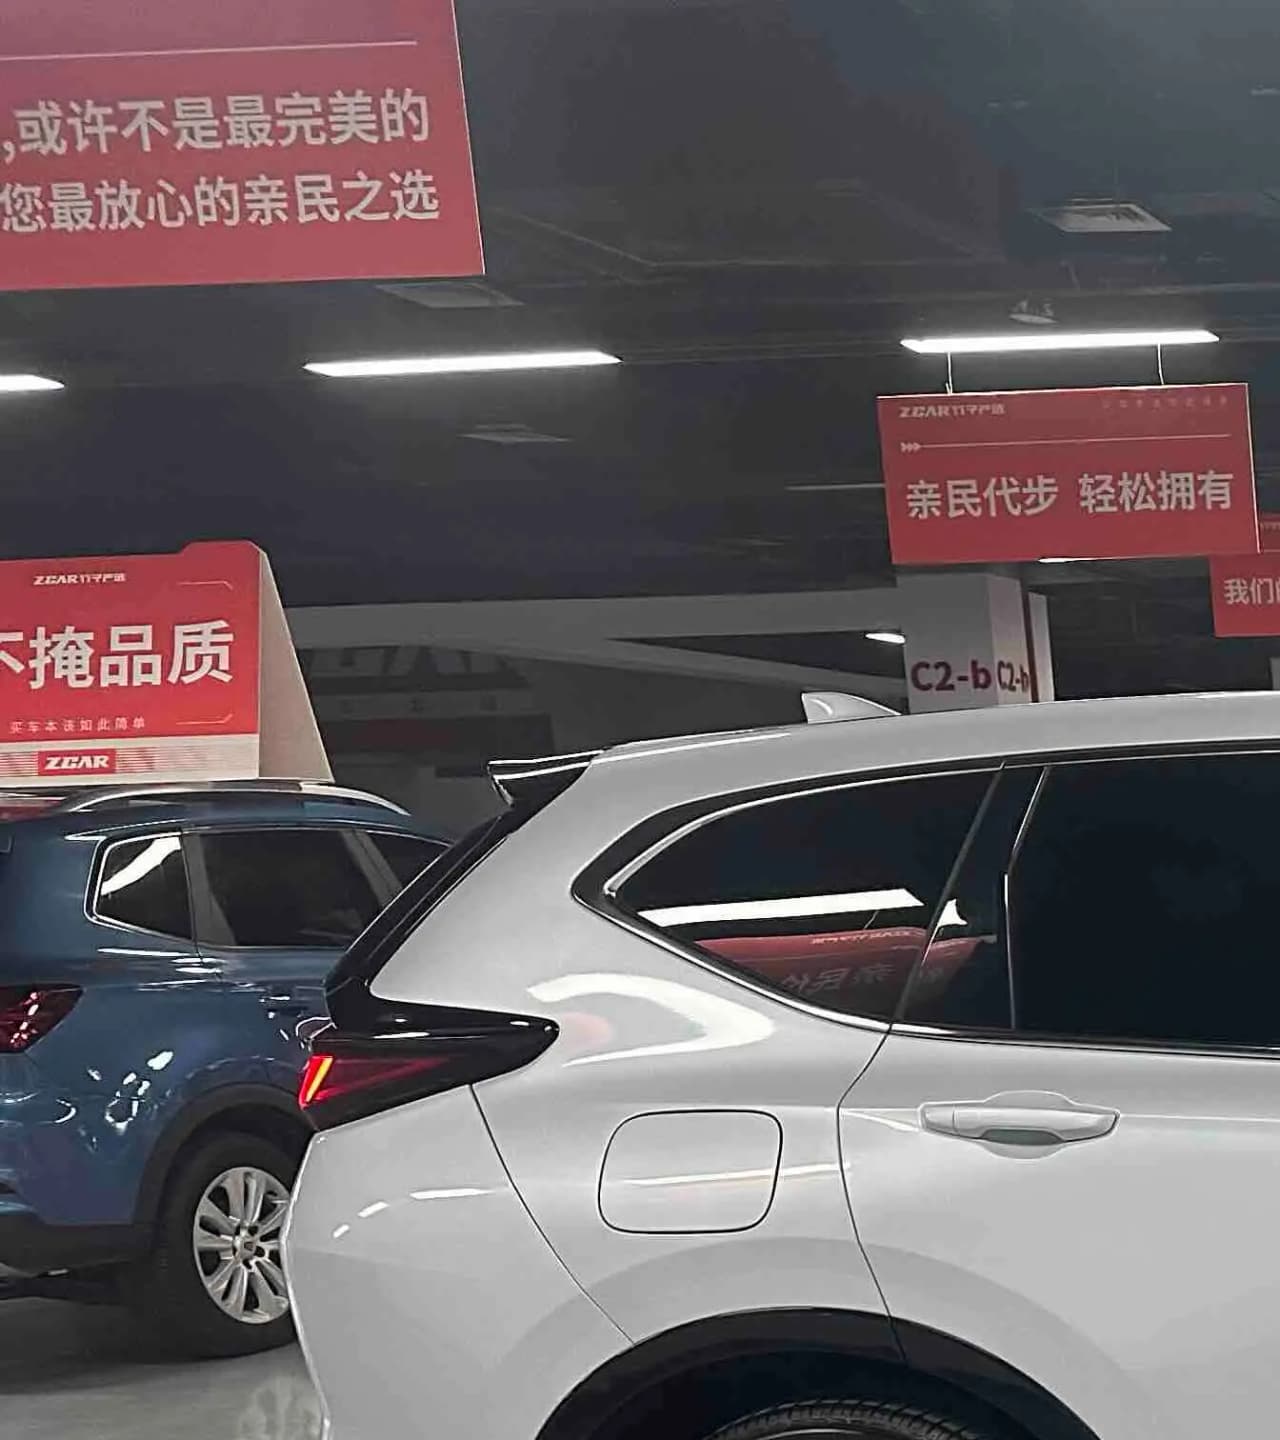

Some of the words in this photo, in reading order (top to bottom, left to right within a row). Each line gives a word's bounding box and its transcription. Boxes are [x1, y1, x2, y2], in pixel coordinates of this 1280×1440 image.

[2, 169, 440, 233] 您最放心的亲民之选
[906, 473, 1059, 519] 亲民代步
[1078, 470, 1234, 514] 轻松拥有
[911, 659, 992, 692] C2-b
[44, 755, 110, 771] ZCAR
